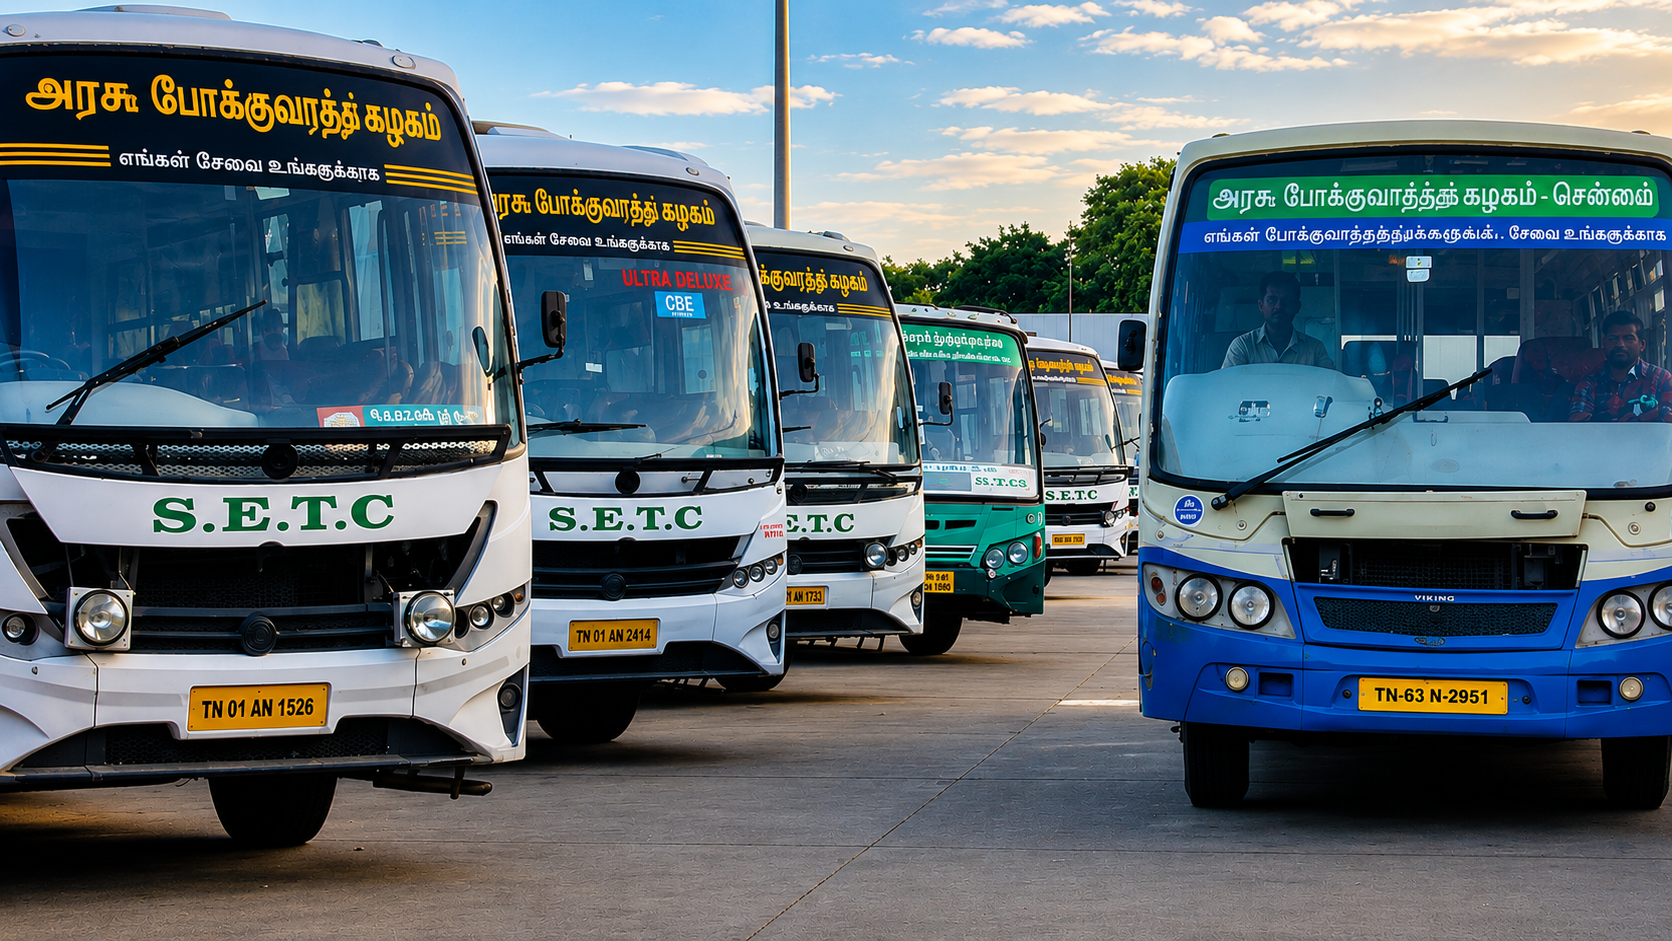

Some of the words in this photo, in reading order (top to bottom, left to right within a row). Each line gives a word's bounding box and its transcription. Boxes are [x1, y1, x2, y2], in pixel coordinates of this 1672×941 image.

[364, 101, 442, 148] கழகம்
[118, 148, 190, 169] எங்கள்
[196, 151, 263, 172] சேவை
[1463, 180, 1537, 214] கழகம்
[662, 199, 716, 232] கழகம்
[503, 231, 547, 246] எங்கள்
[549, 232, 592, 247] சேவை
[1203, 226, 1260, 244] எங்கள்
[1508, 224, 1560, 241] சேவை
[622, 269, 673, 288] ULTRA
[675, 271, 734, 292] DELUXE
[830, 270, 869, 298] கழகம்
[665, 295, 695, 312] CBE
[1044, 489, 1099, 501] S.E.T.C
[152, 493, 395, 534] S.E.T.C
[548, 505, 704, 532] S.E.T.C
[786, 512, 855, 533] E.T.C
[1414, 594, 1456, 602] VIKING
[576, 629, 591, 643] TN
[593, 629, 606, 643] 01
[608, 628, 624, 642] AN
[626, 627, 651, 642] 2414
[1374, 687, 1425, 703] TN-63
[1429, 688, 1488, 705] N-2951
[202, 700, 223, 719] TN
[227, 699, 246, 718] 01
[250, 698, 274, 718] AN
[277, 697, 315, 717] 1526
